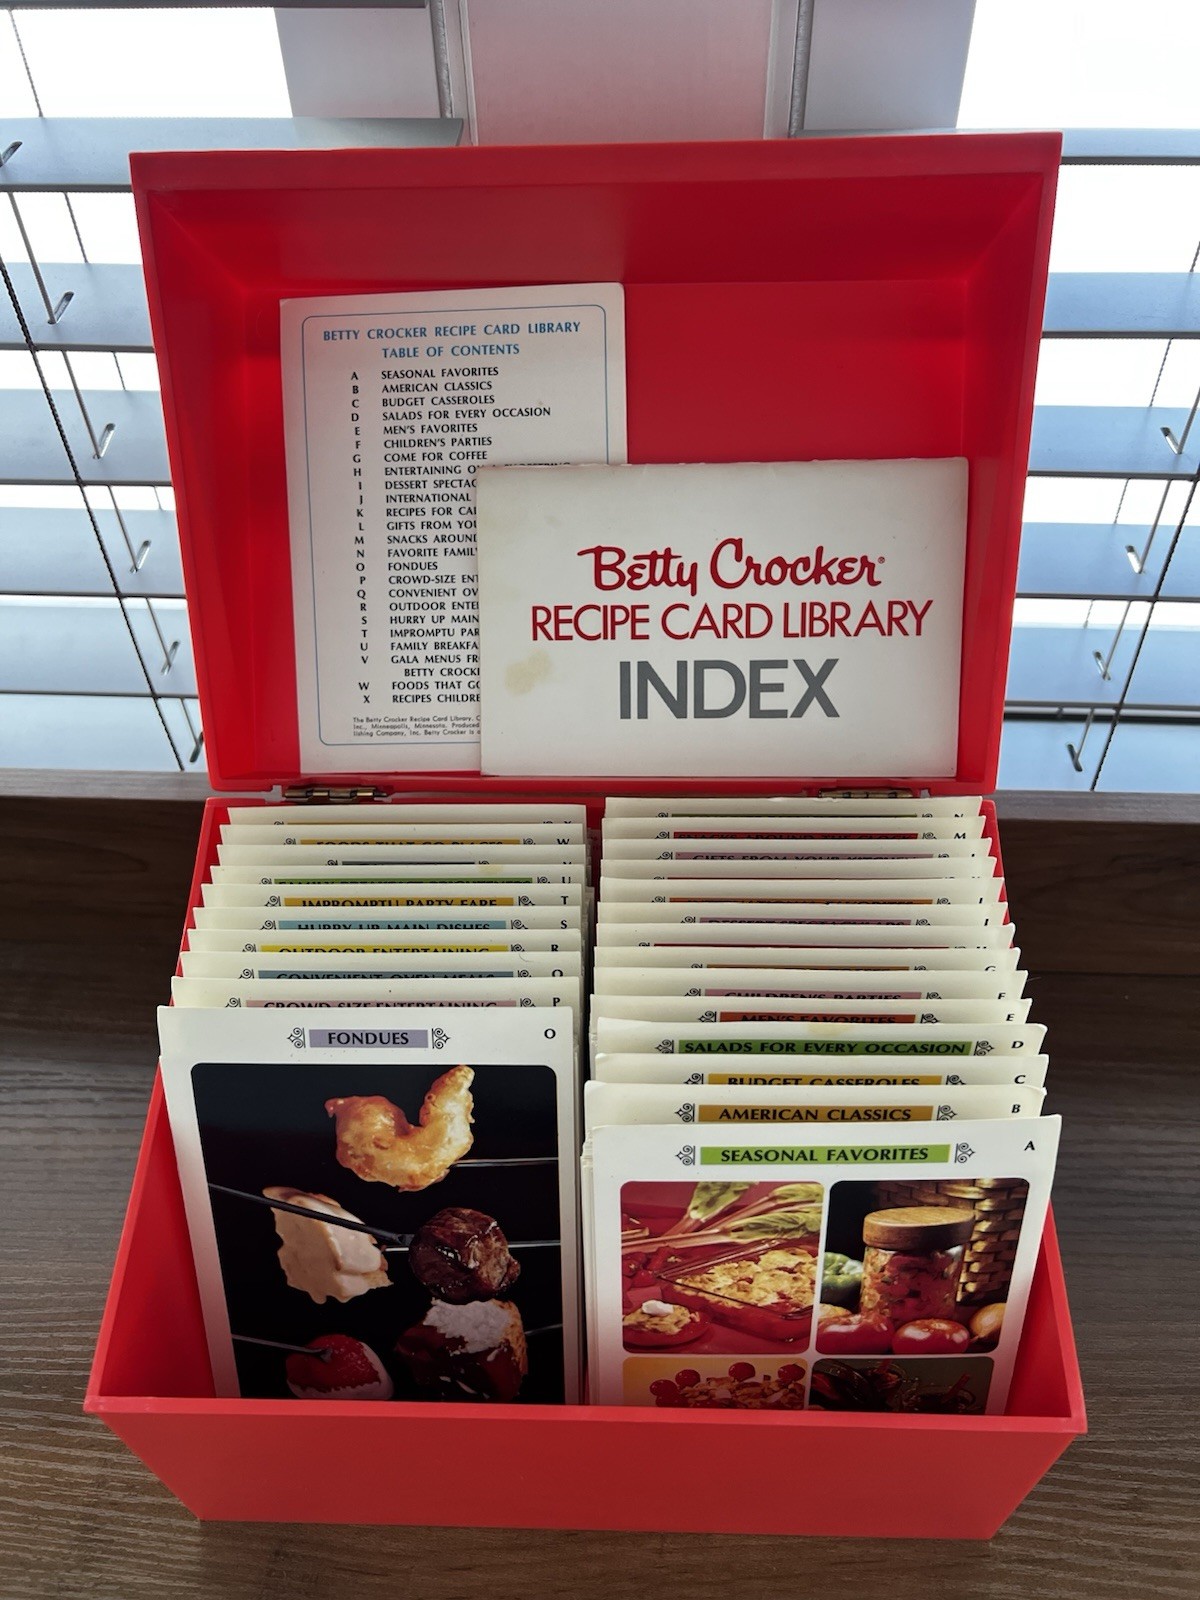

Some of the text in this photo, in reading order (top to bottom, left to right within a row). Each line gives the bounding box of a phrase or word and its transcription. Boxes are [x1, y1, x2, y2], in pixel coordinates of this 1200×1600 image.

[323, 322, 580, 341] BETTY CROCKER RECIPE CARD LIBRARY
[382, 344, 520, 358] TABLE OF CONTENTS
[351, 366, 499, 380] A SEASONAL FAVORITES
[352, 380, 493, 394] B AMERICAN CLASSICS
[351, 394, 495, 409] C BUDGET CASSEROLES
[351, 407, 551, 422] D SALADS FOR EVERY OCCASION
[354, 423, 478, 436] E MEN'S FAVORITES
[355, 436, 492, 449] F CHILDREN'S PARTIES
[352, 450, 487, 463] G COME FOR COFFEE
[353, 465, 477, 477] H ENTERTAINING O
[385, 479, 428, 490] DESSERT
[386, 493, 472, 504] INTERNATIONAL
[356, 509, 364, 517] K
[386, 507, 426, 517] RECIPES
[431, 506, 453, 516] FOR
[358, 522, 364, 531] L
[386, 521, 416, 531] GIFTS
[421, 520, 452, 530] FROM
[354, 536, 364, 544] M
[387, 534, 428, 544] SNACKS
[356, 546, 478, 558] N FAVORITE FAMIL
[356, 561, 438, 572] O FONDUES
[577, 545, 698, 596] Betty
[359, 576, 366, 585] P
[388, 574, 456, 585] CROWD-SIZE
[357, 589, 366, 600] Q
[388, 588, 457, 598] CONVENIENT
[360, 601, 479, 611] R OUTDOOR ENTE
[361, 614, 480, 625] S HURRY UP MAIN
[531, 600, 933, 641] RECIPE CARD LIBRARY
[361, 629, 368, 638] T
[390, 628, 455, 638] IMPROMPTU
[360, 641, 480, 651] U FAMILY BREAKFA
[361, 654, 480, 664] V GALA MENUS FR
[404, 668, 435, 677] BETTY
[358, 682, 370, 691] W
[392, 681, 429, 690] FOODS
[434, 680, 462, 690] THAT
[619, 658, 840, 720] INDEX
[363, 695, 370, 704] X
[392, 694, 432, 703] RECIPES
[561, 896, 569, 905] T
[561, 920, 567, 929] S
[553, 997, 561, 1007] P
[1006, 1013, 1015, 1021] E
[327, 1028, 556, 1045] FONDUES O
[685, 1041, 1024, 1053] SALADS FOR EVERY OCCASION D
[1014, 1074, 1026, 1084] C
[719, 1104, 1022, 1121] AMERICAN CLASSICS B
[720, 1139, 1036, 1163] SEASONAL FAVORITES A
